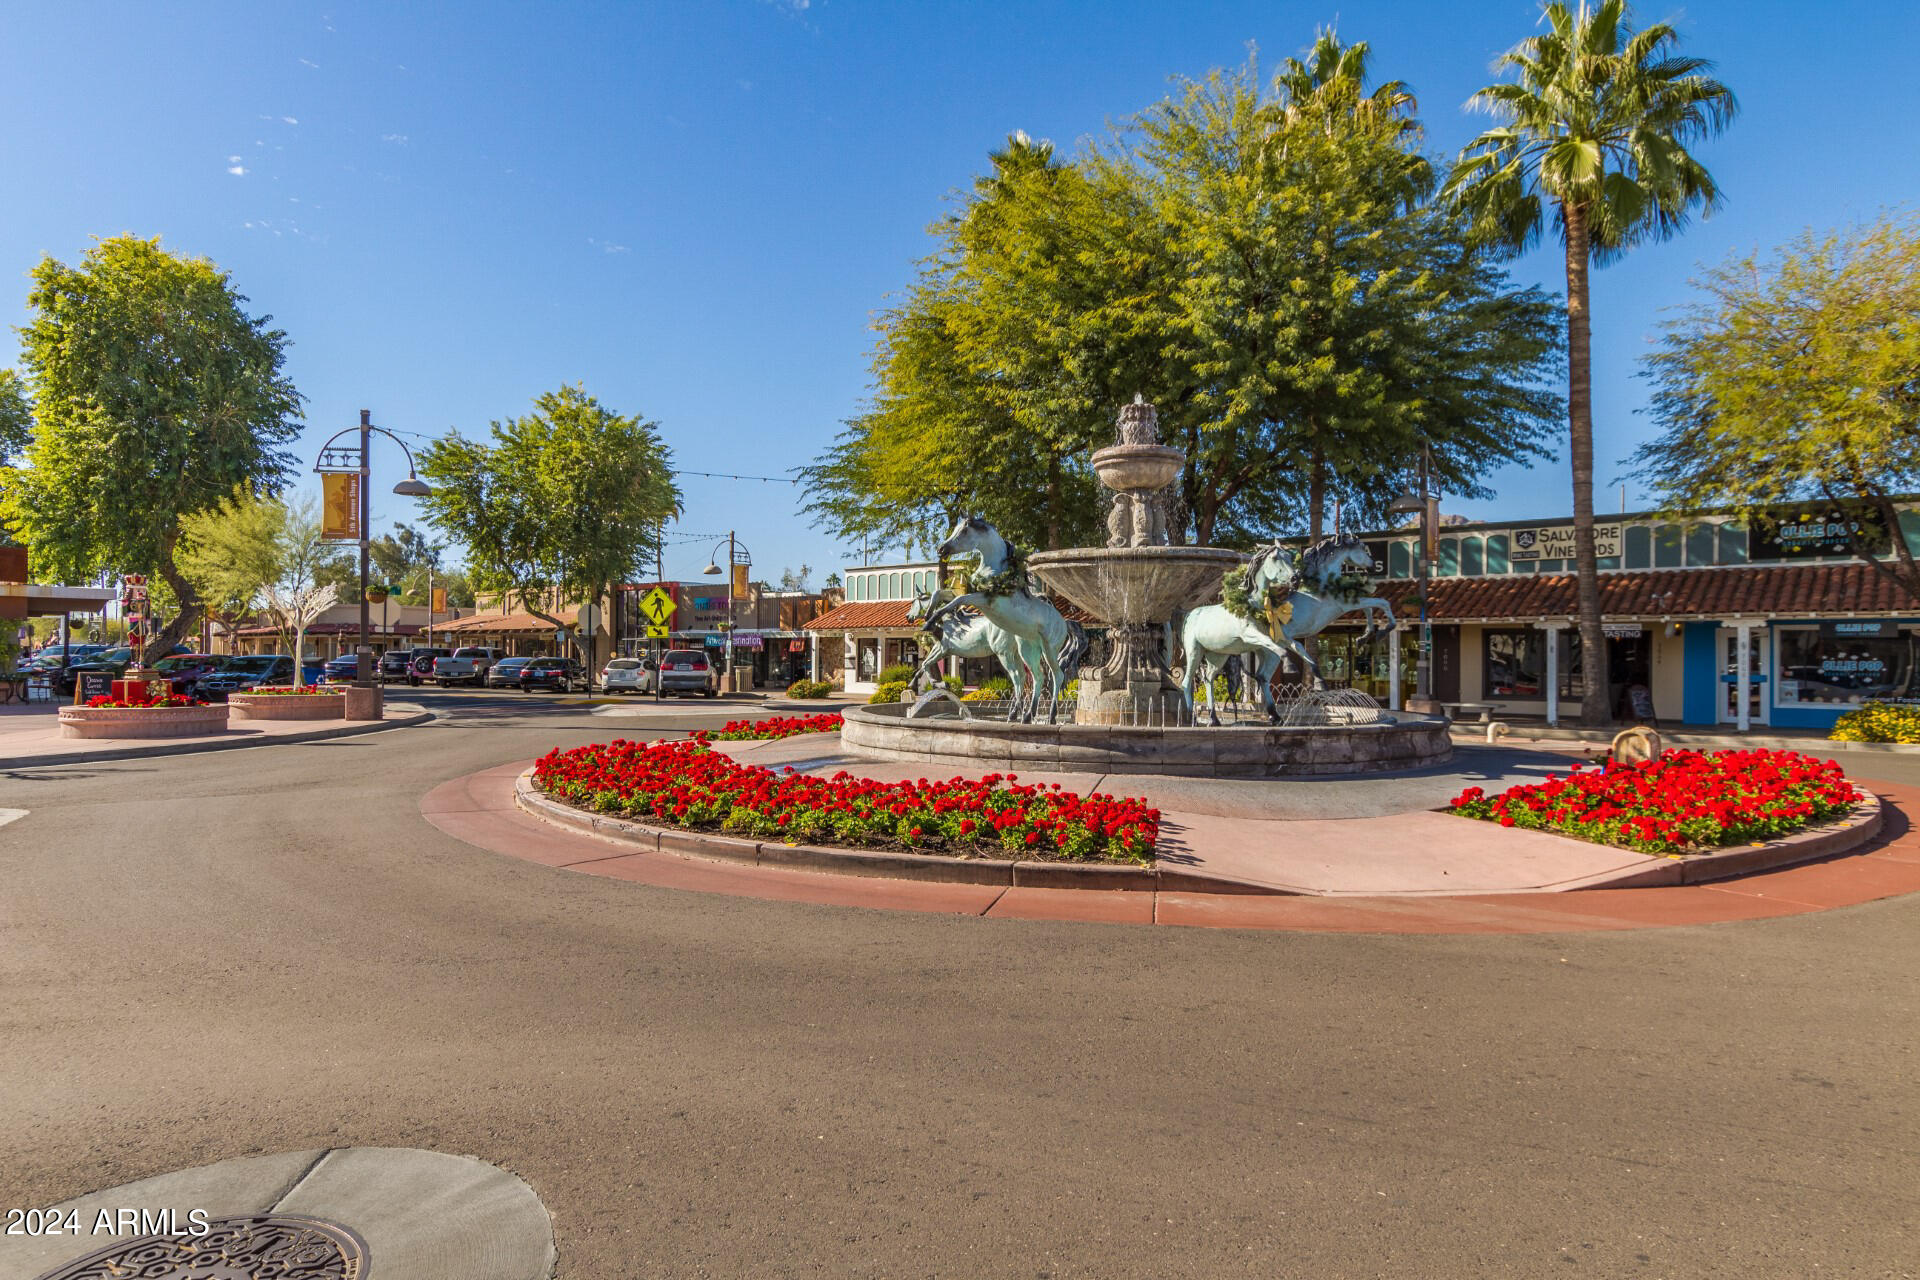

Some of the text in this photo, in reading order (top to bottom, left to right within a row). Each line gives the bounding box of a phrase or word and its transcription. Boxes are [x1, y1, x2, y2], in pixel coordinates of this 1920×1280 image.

[1539, 527, 1619, 543] SALVORE
[1780, 524, 1825, 539] OLLIE
[1604, 630, 1641, 638] TASTING
[1823, 661, 1884, 671] OLLIE POP
